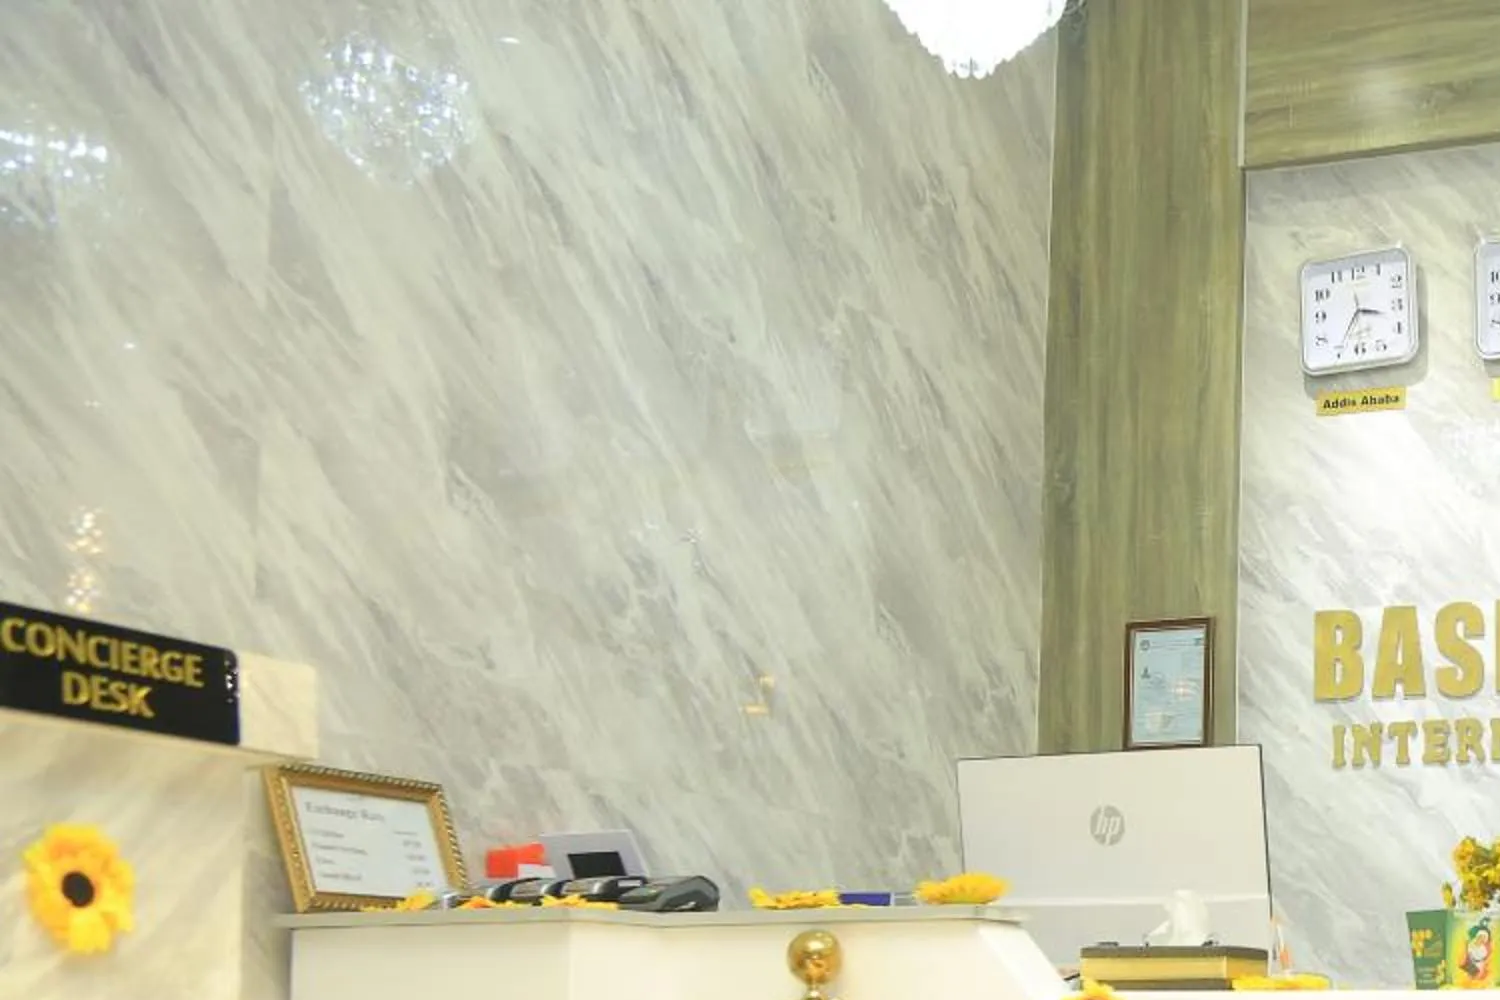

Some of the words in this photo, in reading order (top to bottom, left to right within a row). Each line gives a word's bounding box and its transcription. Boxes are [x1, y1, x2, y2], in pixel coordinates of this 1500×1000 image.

[1331, 270, 1343, 284] 11
[1352, 265, 1366, 281] 12
[1315, 288, 1331, 302] 10
[1391, 298, 1403, 311] 3
[1315, 310, 1327, 324] 9
[1354, 342, 1367, 356] 6
[1323, 397, 1357, 410] Addis
[0, 616, 204, 688] CONCIERGE
[61, 669, 155, 718] DESK
[1093, 806, 1122, 846] hp
